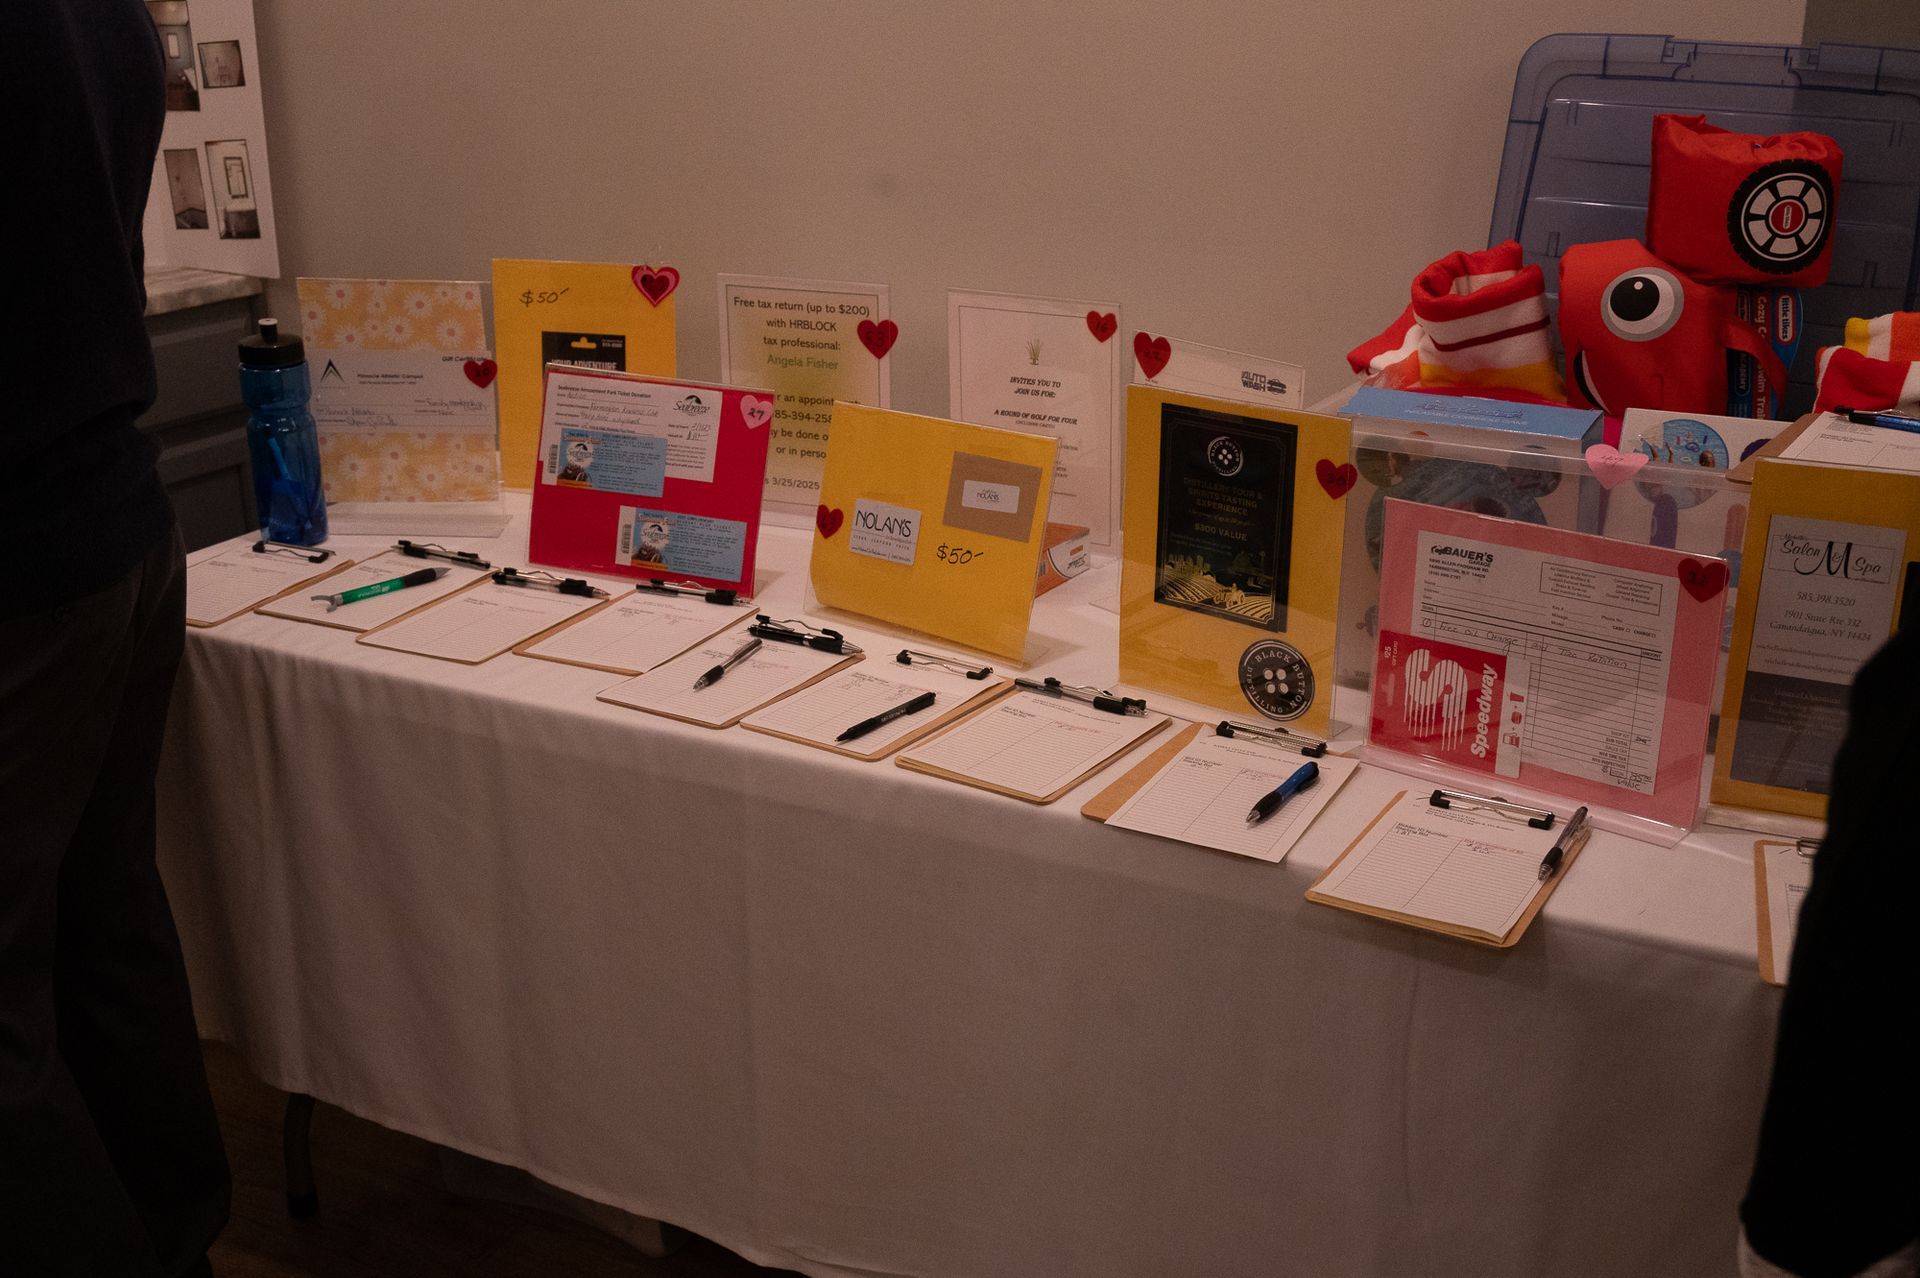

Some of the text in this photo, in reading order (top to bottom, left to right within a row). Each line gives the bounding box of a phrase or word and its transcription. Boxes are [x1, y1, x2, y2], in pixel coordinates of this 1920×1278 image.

[734, 297, 870, 317] Free tax return (up to $200)
[1754, 296, 1767, 323] Cozy
[766, 319, 838, 331] with HRBLOCK
[763, 337, 841, 351] tax professional:
[767, 354, 838, 369] Angela Fisher
[1010, 376, 1036, 386] INVITES
[1037, 379, 1051, 387] YOU
[1241, 371, 1267, 384] AUTO
[784, 394, 795, 402] an
[1031, 389, 1040, 397] US
[1001, 409, 1021, 418] ROUND
[1031, 413, 1048, 421] GOLF
[1061, 417, 1078, 425] FOUR
[781, 428, 793, 437] be
[796, 429, 819, 440] done
[776, 446, 827, 459] or in perso
[772, 477, 820, 490] 3/25/2025
[856, 510, 912, 537] NOLAN'S
[1218, 526, 1249, 542] VALUE
[1442, 546, 1494, 563] BAUER'S
[1780, 539, 1821, 557] Salon
[1853, 556, 1883, 576] Spa
[1468, 560, 1491, 568] GARAGE
[1784, 609, 1803, 620] 1901
[1805, 612, 1827, 623] State
[1769, 621, 1827, 637] Canandaigua,
[1830, 628, 1846, 638] NY
[1254, 650, 1291, 664] BLACK
[1246, 666, 1284, 713] DISTILLING
[1288, 663, 1307, 709] BUTTON
[1470, 663, 1499, 759] Speedway
